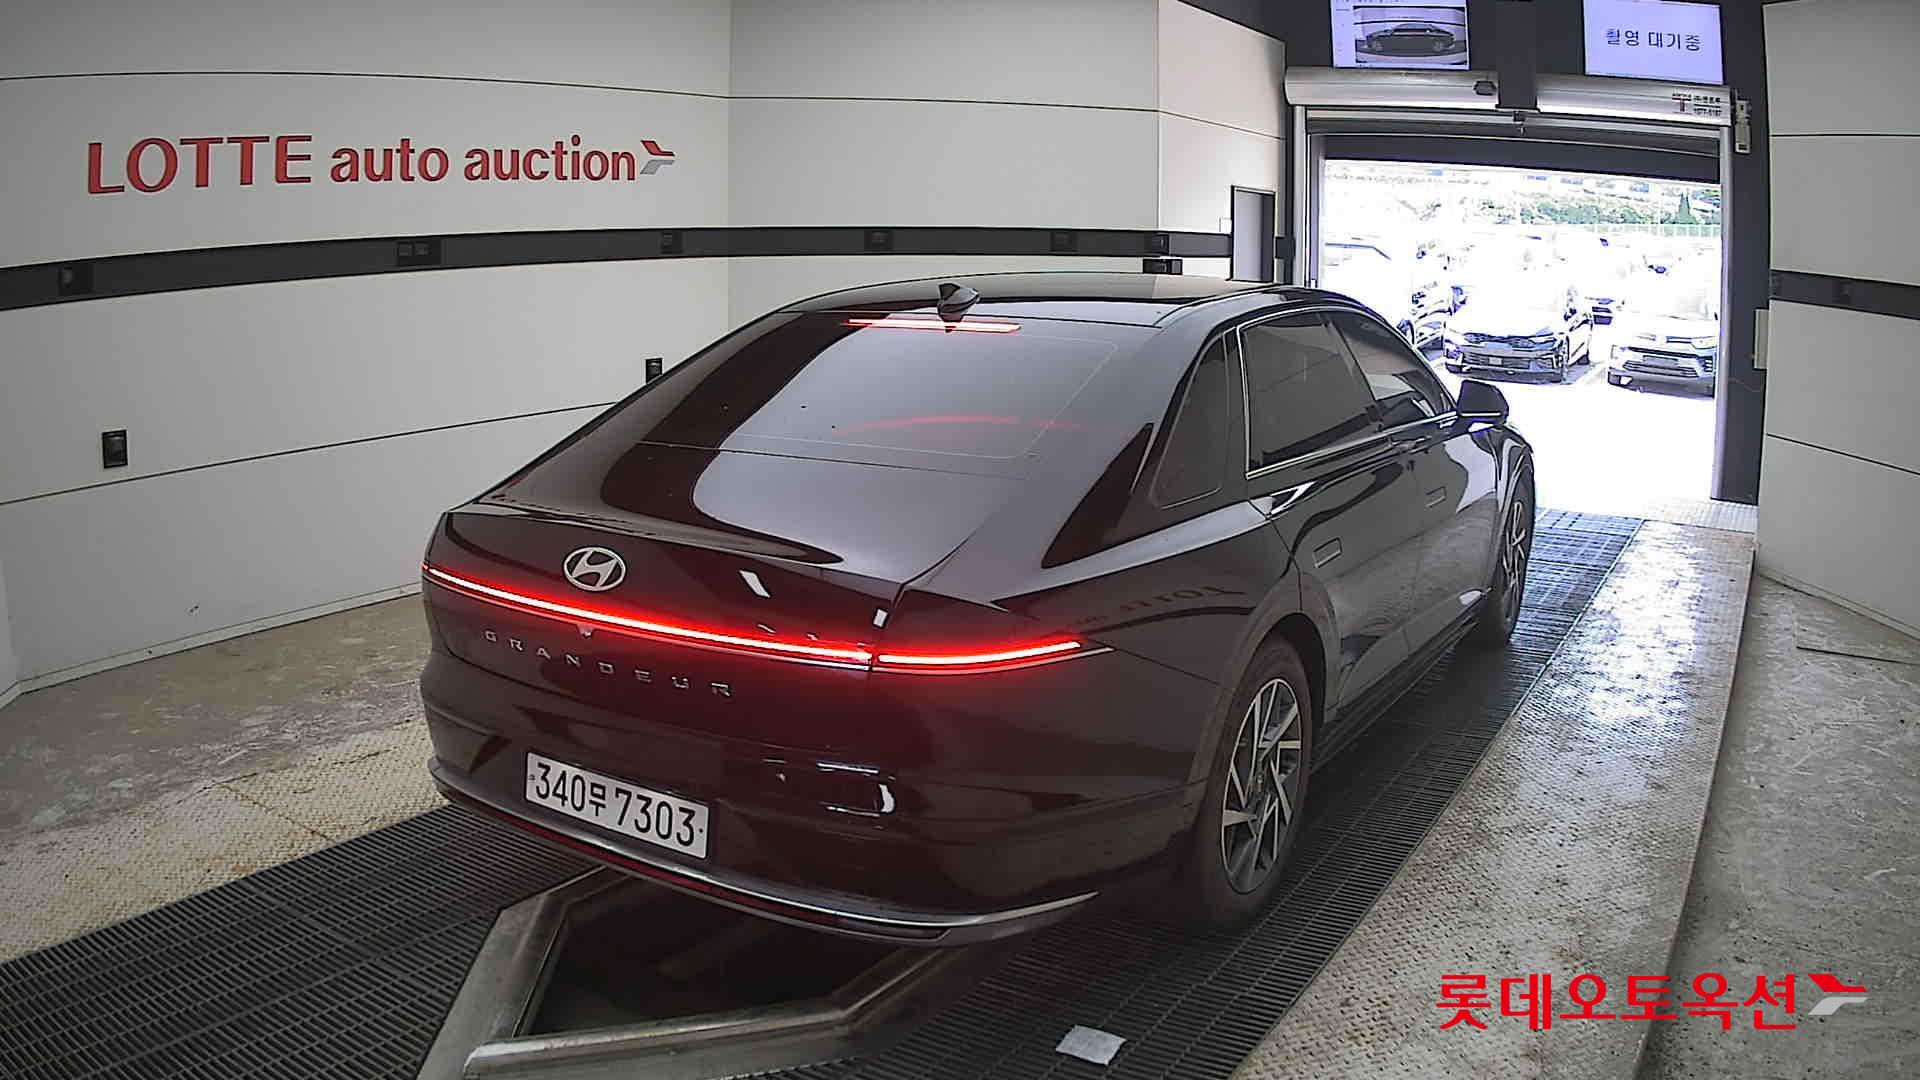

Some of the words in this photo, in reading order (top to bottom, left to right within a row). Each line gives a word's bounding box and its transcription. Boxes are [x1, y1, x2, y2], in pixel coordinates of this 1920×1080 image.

[87, 135, 312, 194] LOTTE
[330, 138, 449, 182] auto
[464, 134, 636, 181] auction
[484, 629, 731, 697] GRANDEUR
